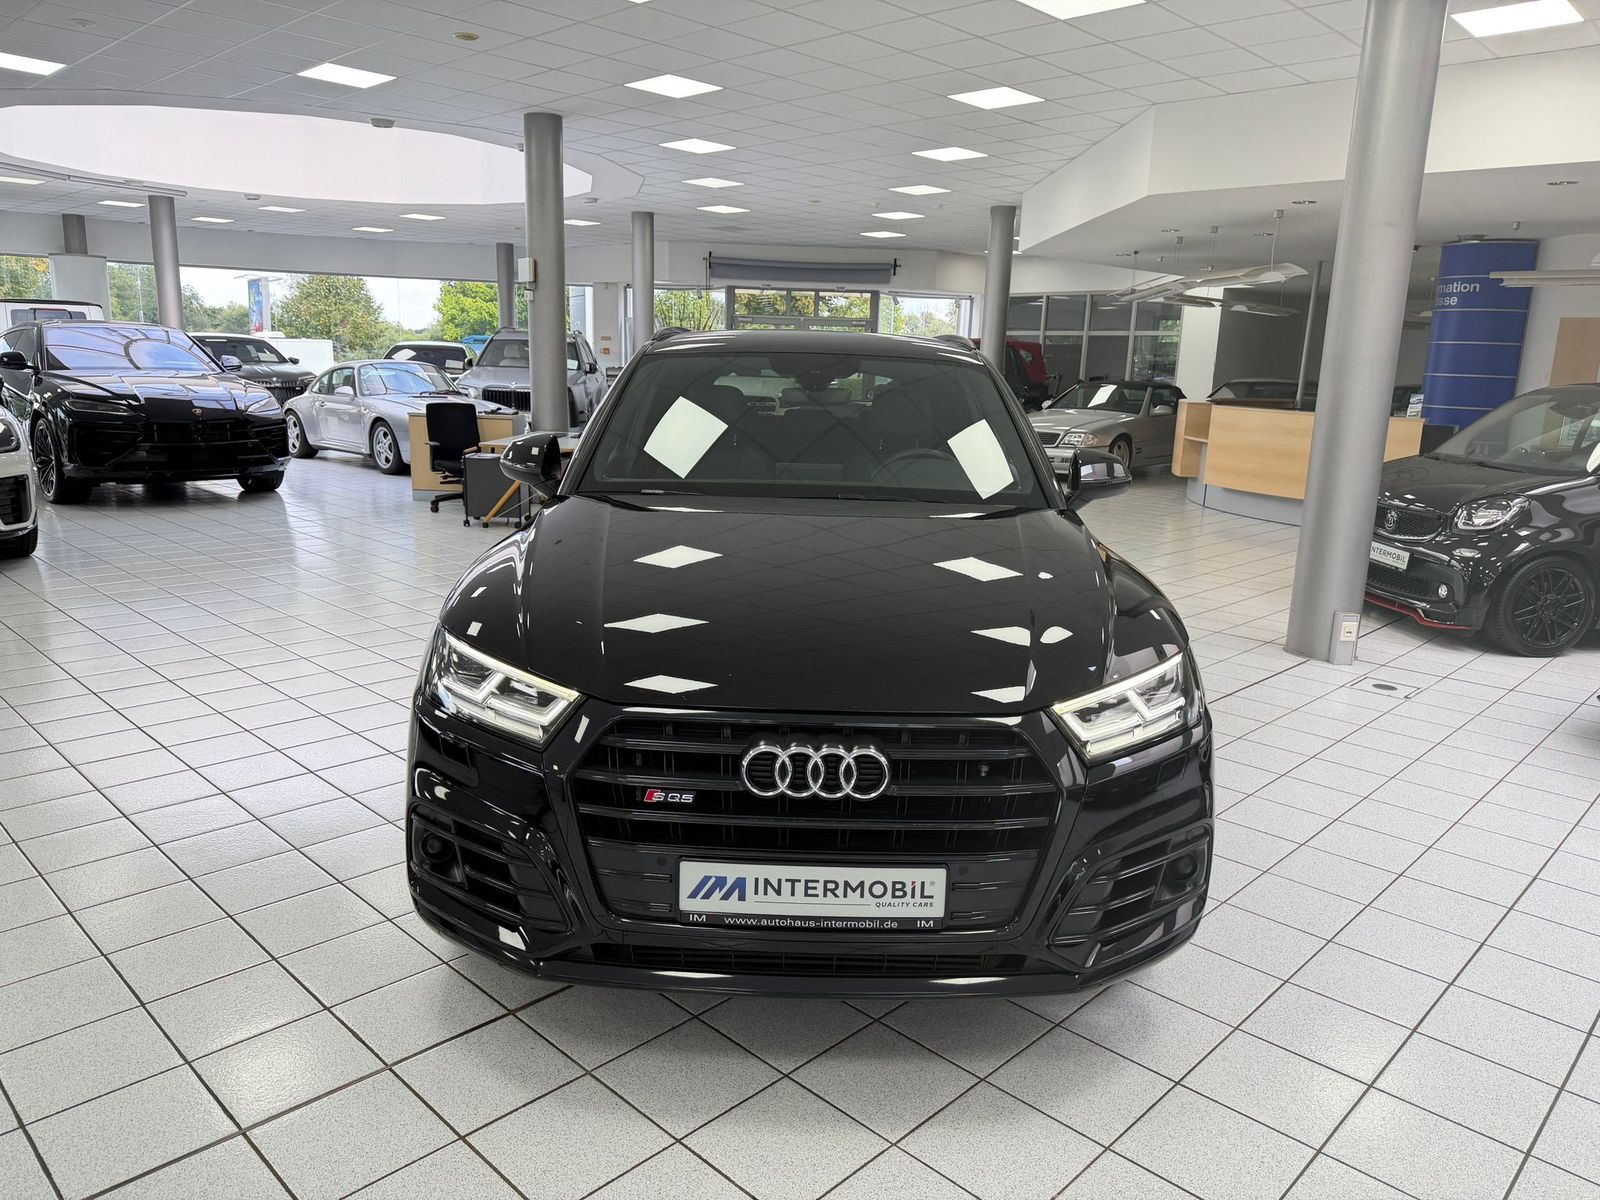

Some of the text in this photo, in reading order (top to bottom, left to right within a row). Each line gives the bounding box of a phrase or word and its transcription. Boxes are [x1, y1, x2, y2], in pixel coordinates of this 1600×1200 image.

[689, 913, 934, 928] IM www.autohaus-intermobil.de IM
